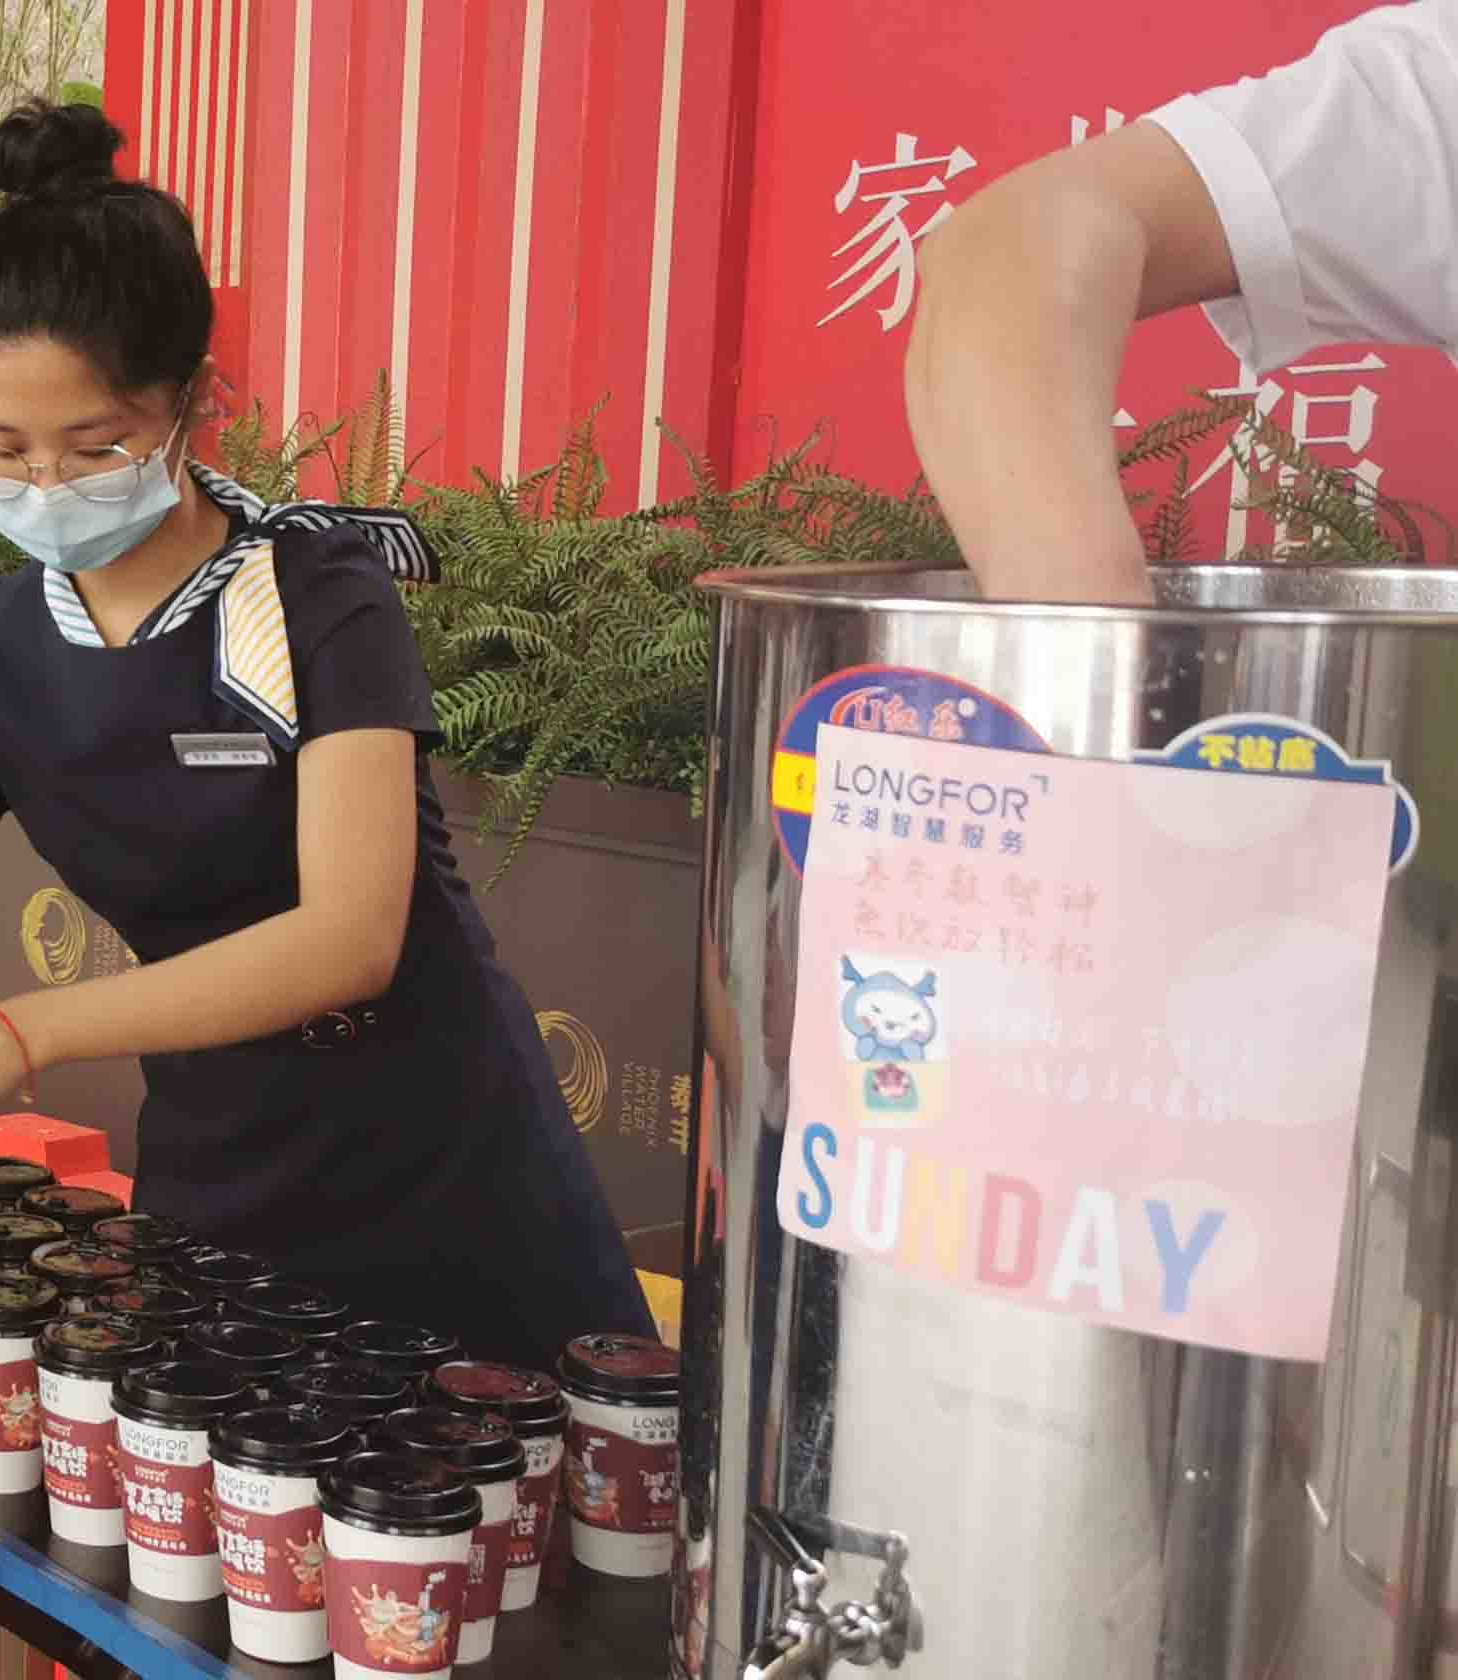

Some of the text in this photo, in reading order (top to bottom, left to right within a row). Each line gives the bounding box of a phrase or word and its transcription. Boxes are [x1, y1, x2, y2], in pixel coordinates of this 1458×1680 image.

[834, 759, 1029, 822] LONGFOR
[830, 800, 1024, 855] 龙湖智慧服务
[796, 1122, 1229, 1316] SUNDAY
